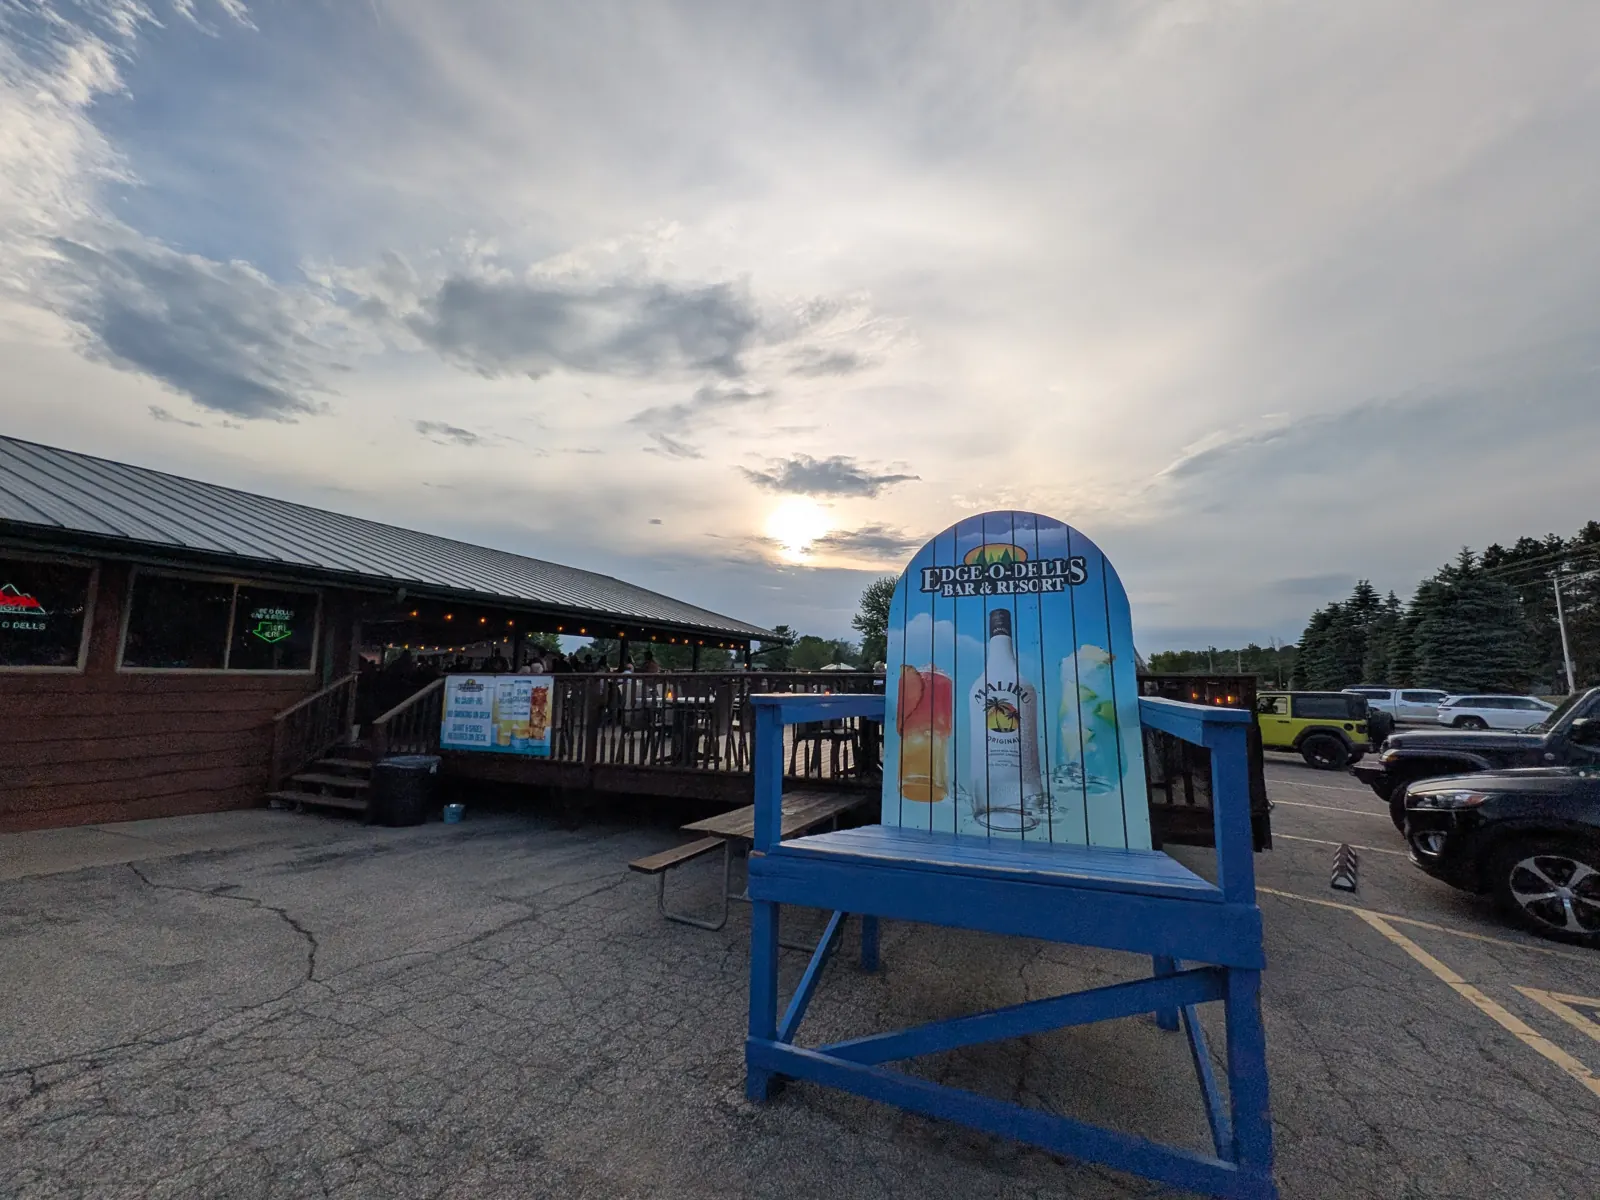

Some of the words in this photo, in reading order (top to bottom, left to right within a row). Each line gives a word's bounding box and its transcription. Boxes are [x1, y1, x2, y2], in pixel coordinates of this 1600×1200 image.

[922, 558, 1086, 591] EDGE-O-DELLS
[943, 583, 976, 596] BAR
[980, 581, 993, 594] &
[996, 578, 1064, 594] RESORT
[13, 621, 46, 630] DELLS
[974, 681, 1032, 704] MALIBU
